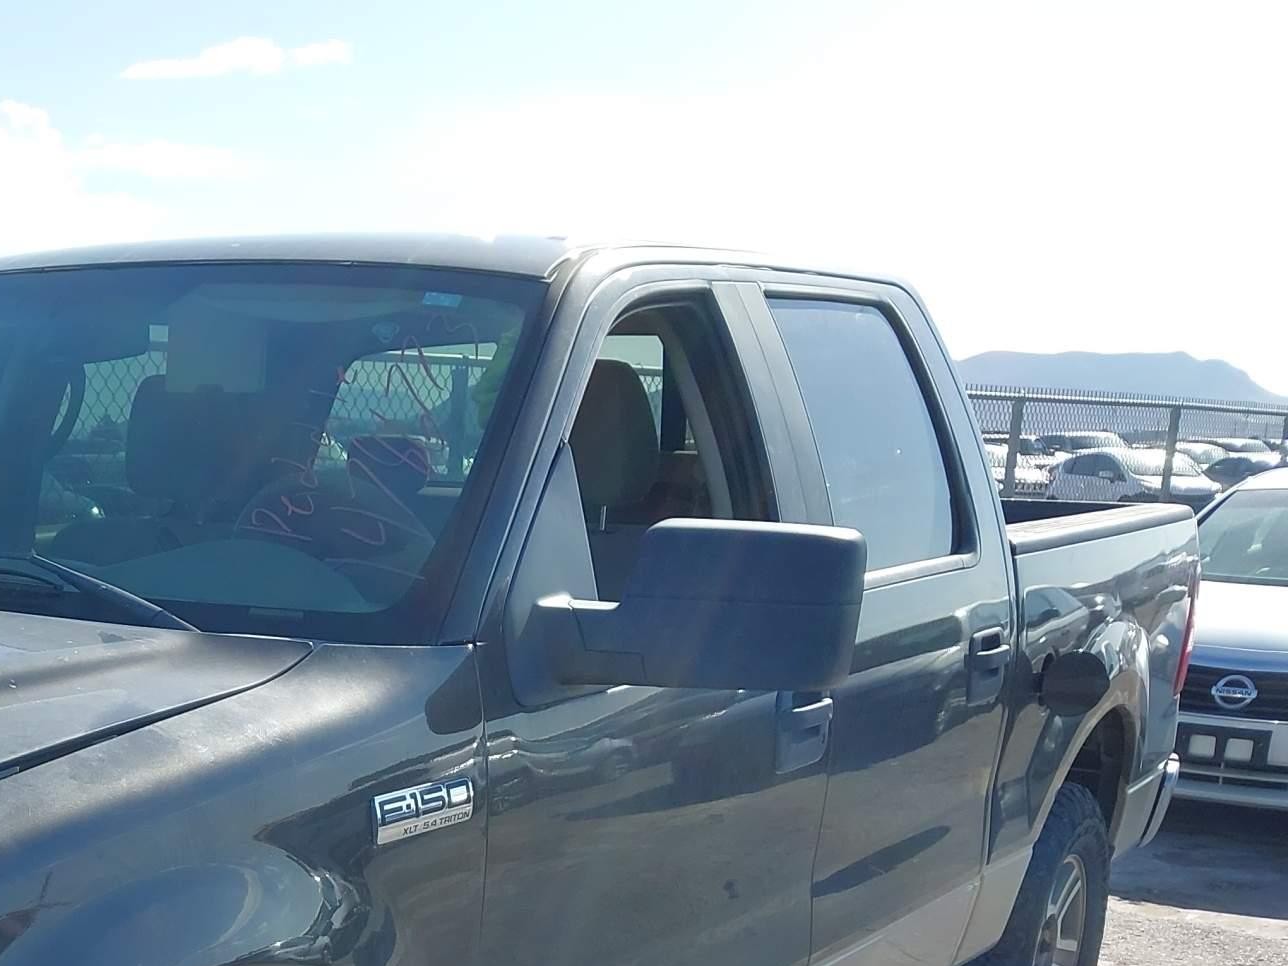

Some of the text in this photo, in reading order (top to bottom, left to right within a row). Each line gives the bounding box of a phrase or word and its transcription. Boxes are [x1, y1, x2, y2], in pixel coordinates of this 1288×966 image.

[1216, 687, 1252, 696] NISSAN
[377, 778, 472, 827] F-150
[402, 824, 419, 836] XLT
[439, 811, 470, 825] TRITON
